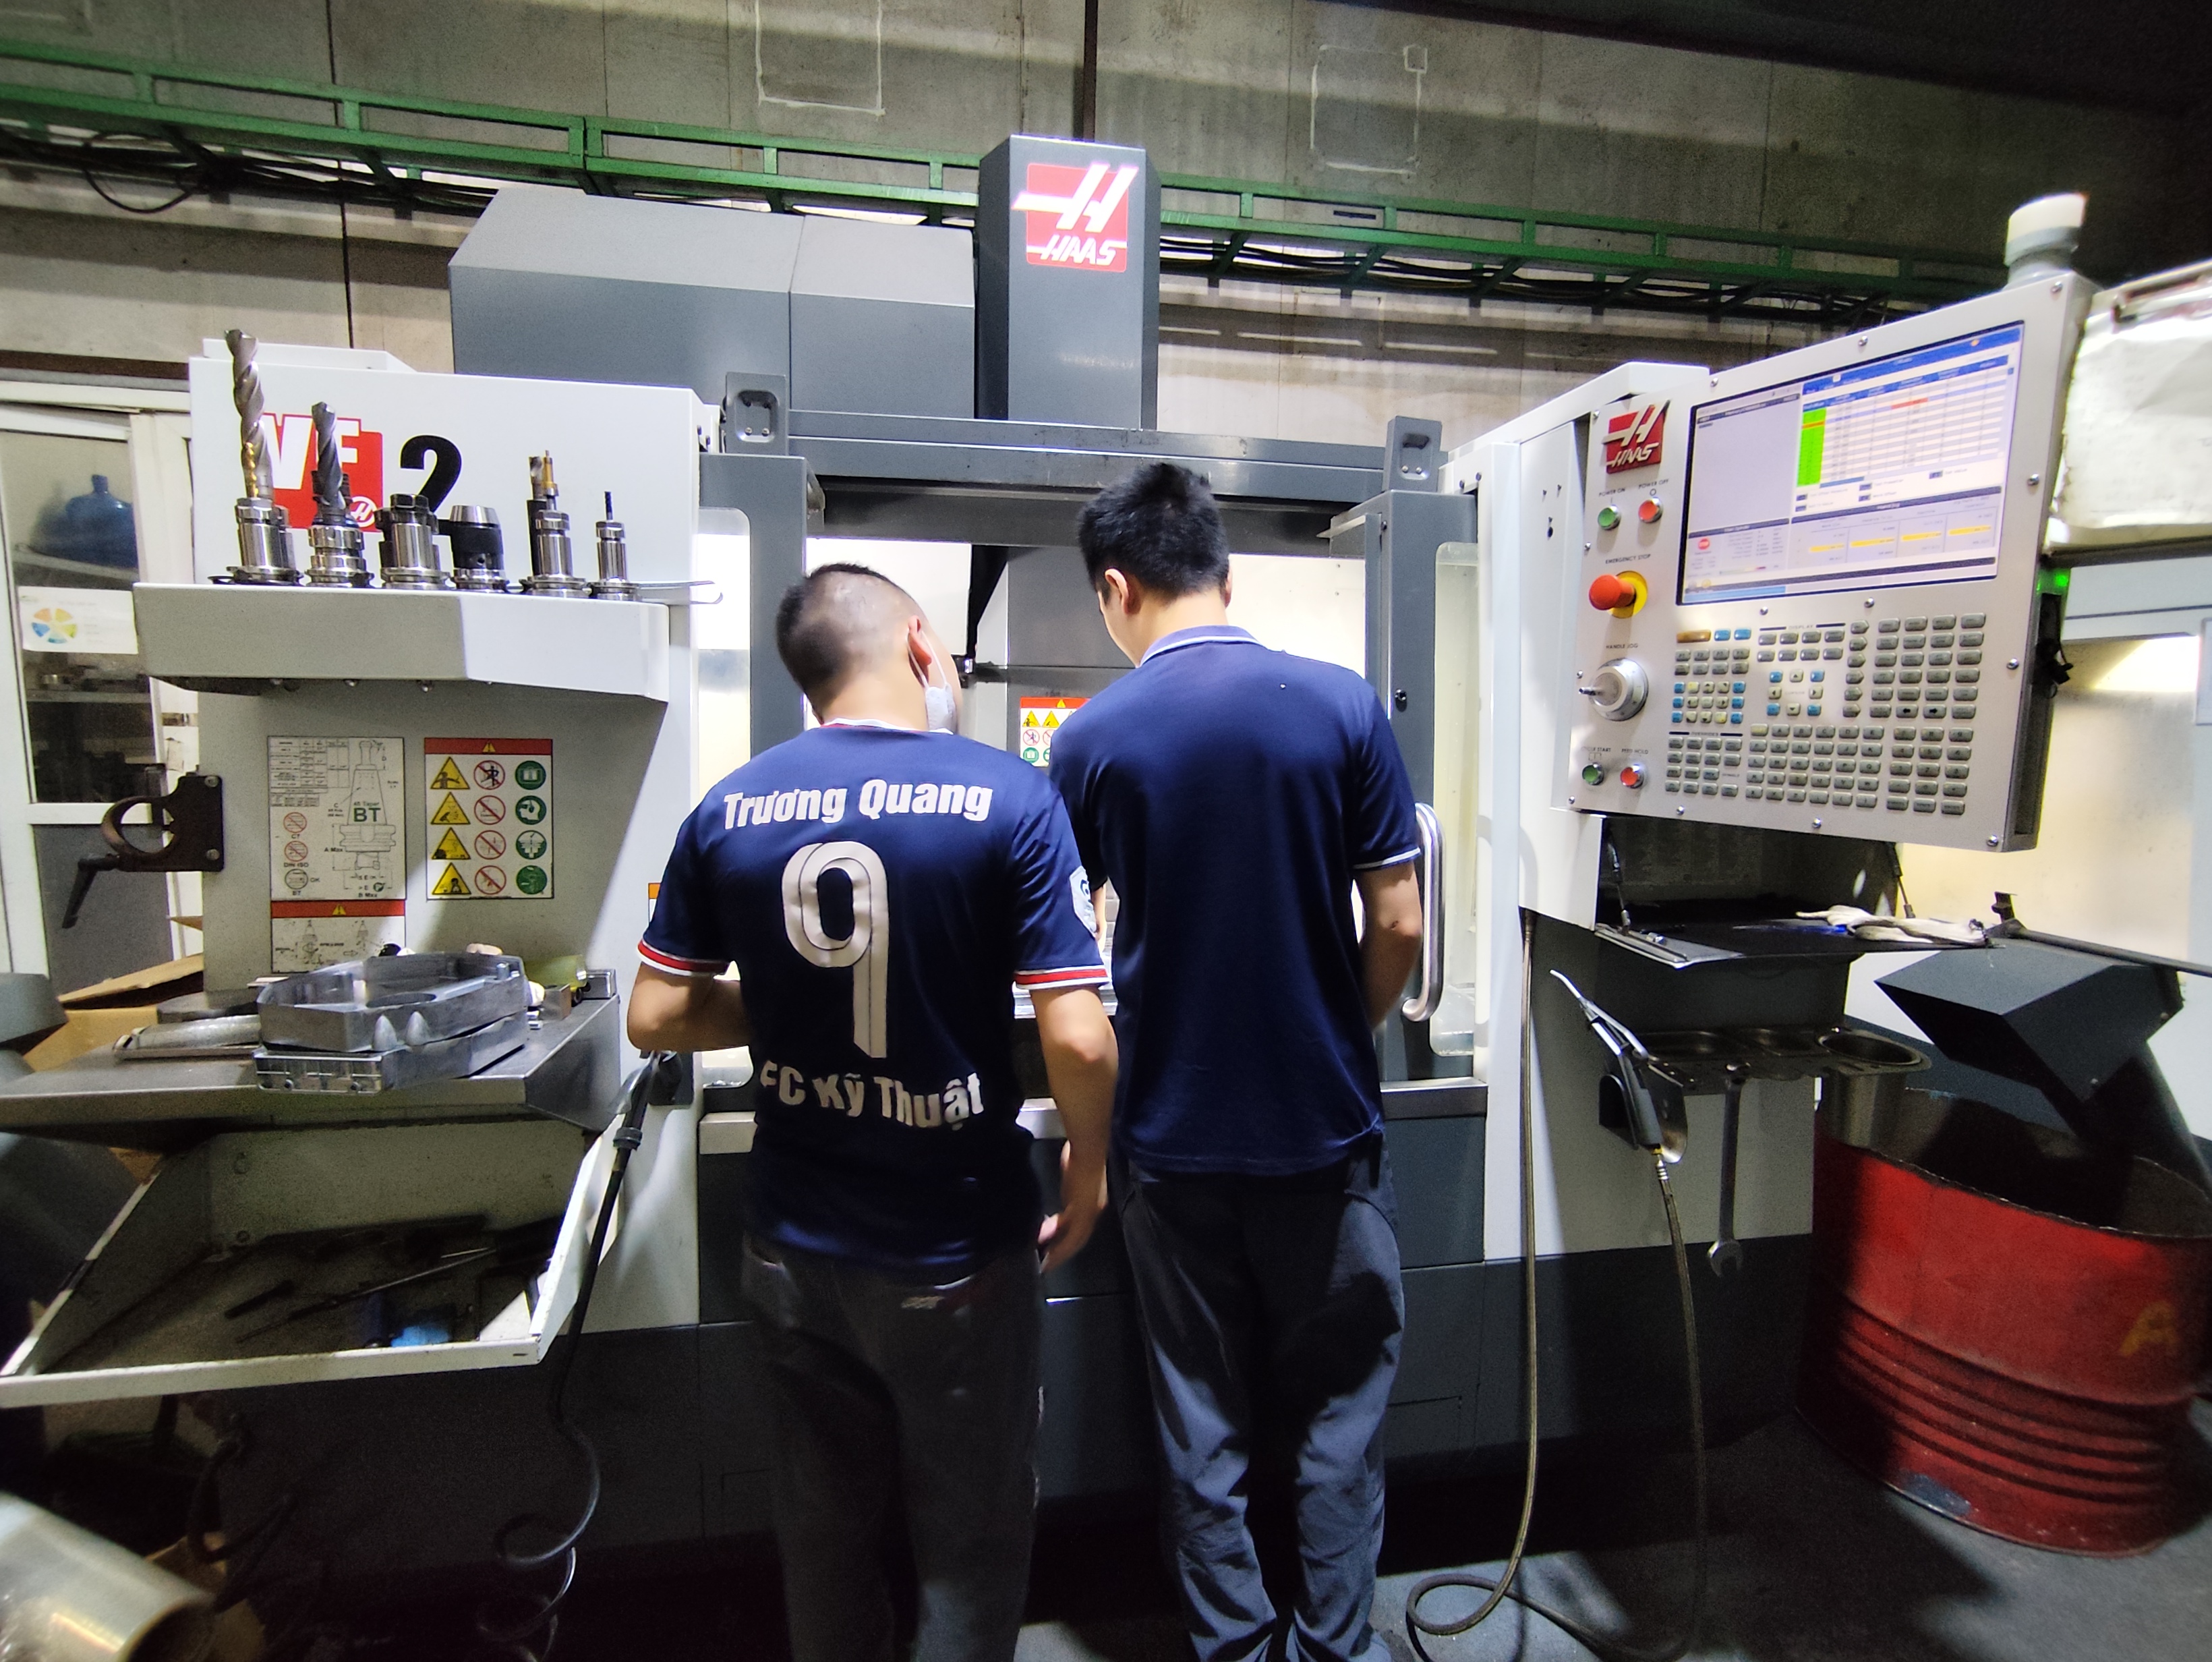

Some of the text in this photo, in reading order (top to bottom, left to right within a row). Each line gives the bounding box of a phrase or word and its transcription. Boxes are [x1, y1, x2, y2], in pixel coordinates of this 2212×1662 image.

[1026, 234, 1127, 266] HAAS
[1606, 442, 1660, 468] HAAS
[400, 434, 463, 536] 2
[1639, 481, 1657, 489] POWER
[1605, 555, 1637, 565] EMERGENCY
[353, 807, 381, 822] BT
[723, 778, 993, 830] Trương Quang
[781, 840, 890, 1058] 9
[811, 1072, 865, 1118] Kỹ
[873, 1072, 985, 1131] Thuật
